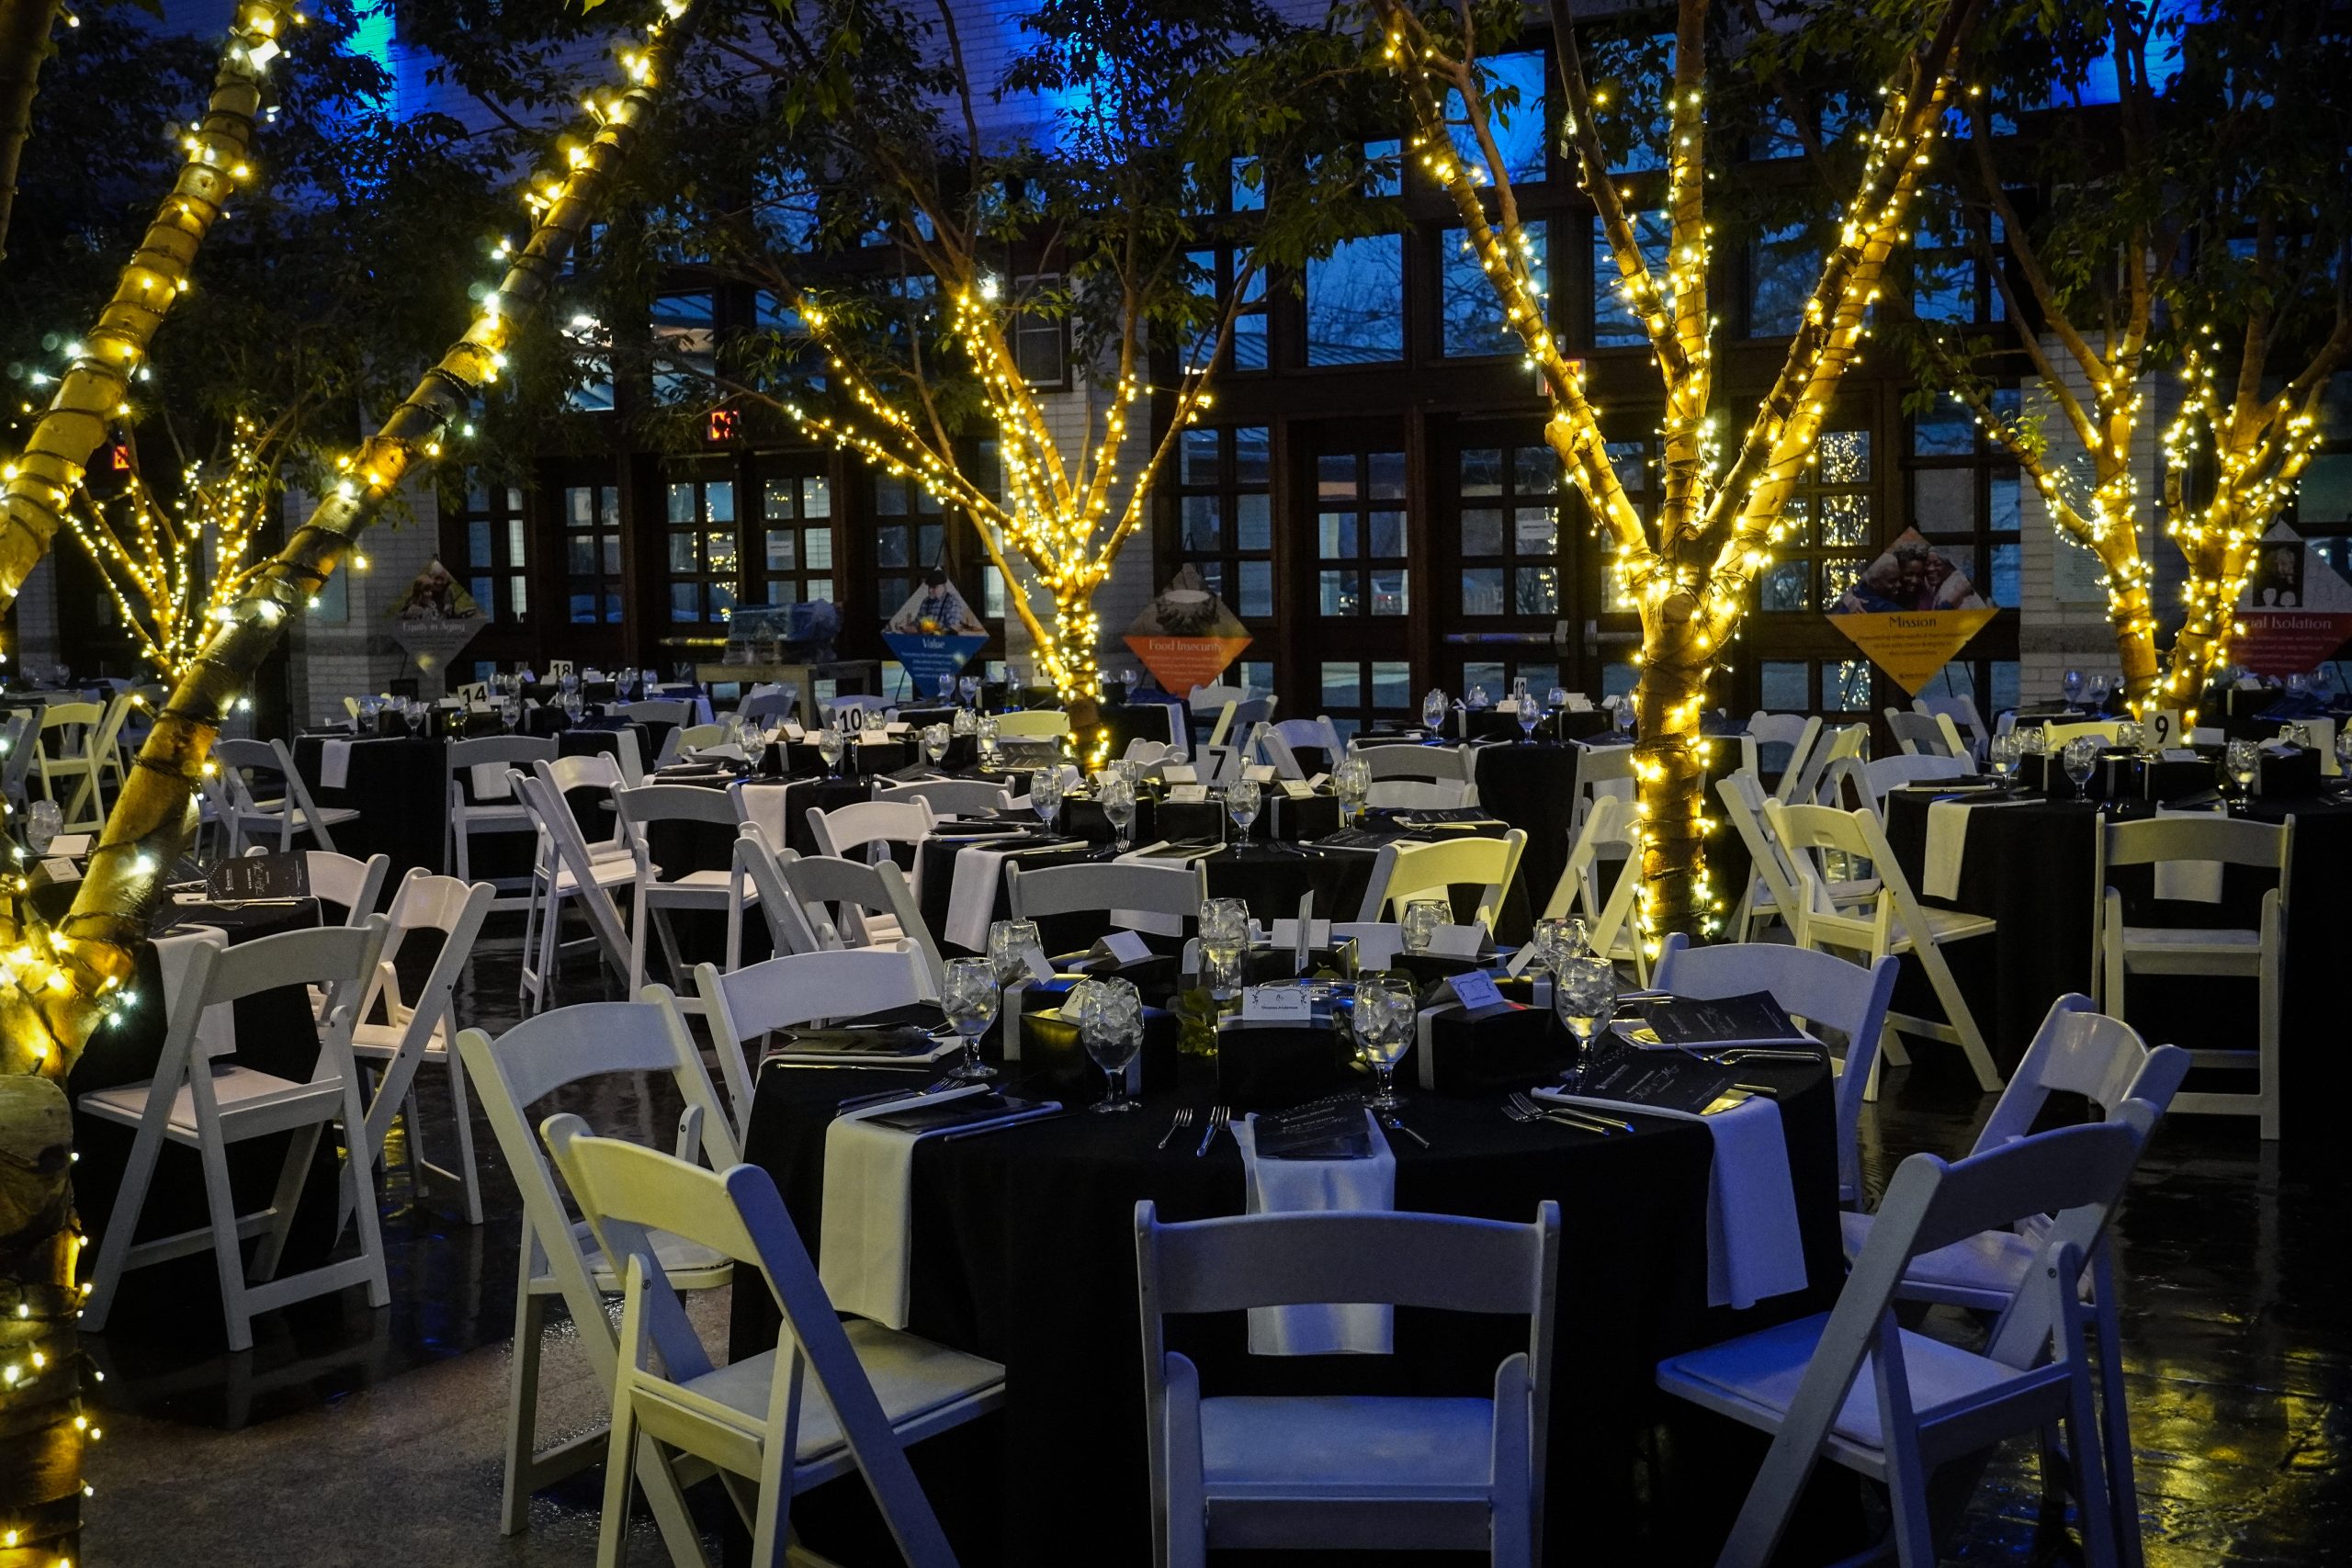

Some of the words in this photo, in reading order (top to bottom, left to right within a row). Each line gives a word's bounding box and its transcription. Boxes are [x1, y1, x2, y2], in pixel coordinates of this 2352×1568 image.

[402, 622, 427, 633] Equity
[440, 622, 466, 633] Aging
[1889, 616, 1937, 627] Mission
[2272, 615, 2332, 629] Isolation
[922, 637, 945, 649] Value
[1148, 638, 1175, 650] Food
[1177, 639, 1221, 652] Insecurity
[553, 663, 571, 676] 18
[462, 685, 487, 705] 14
[1515, 681, 1525, 700] 13
[840, 708, 862, 733] 10
[2154, 715, 2169, 744] 9
[1209, 750, 1227, 780] 7
